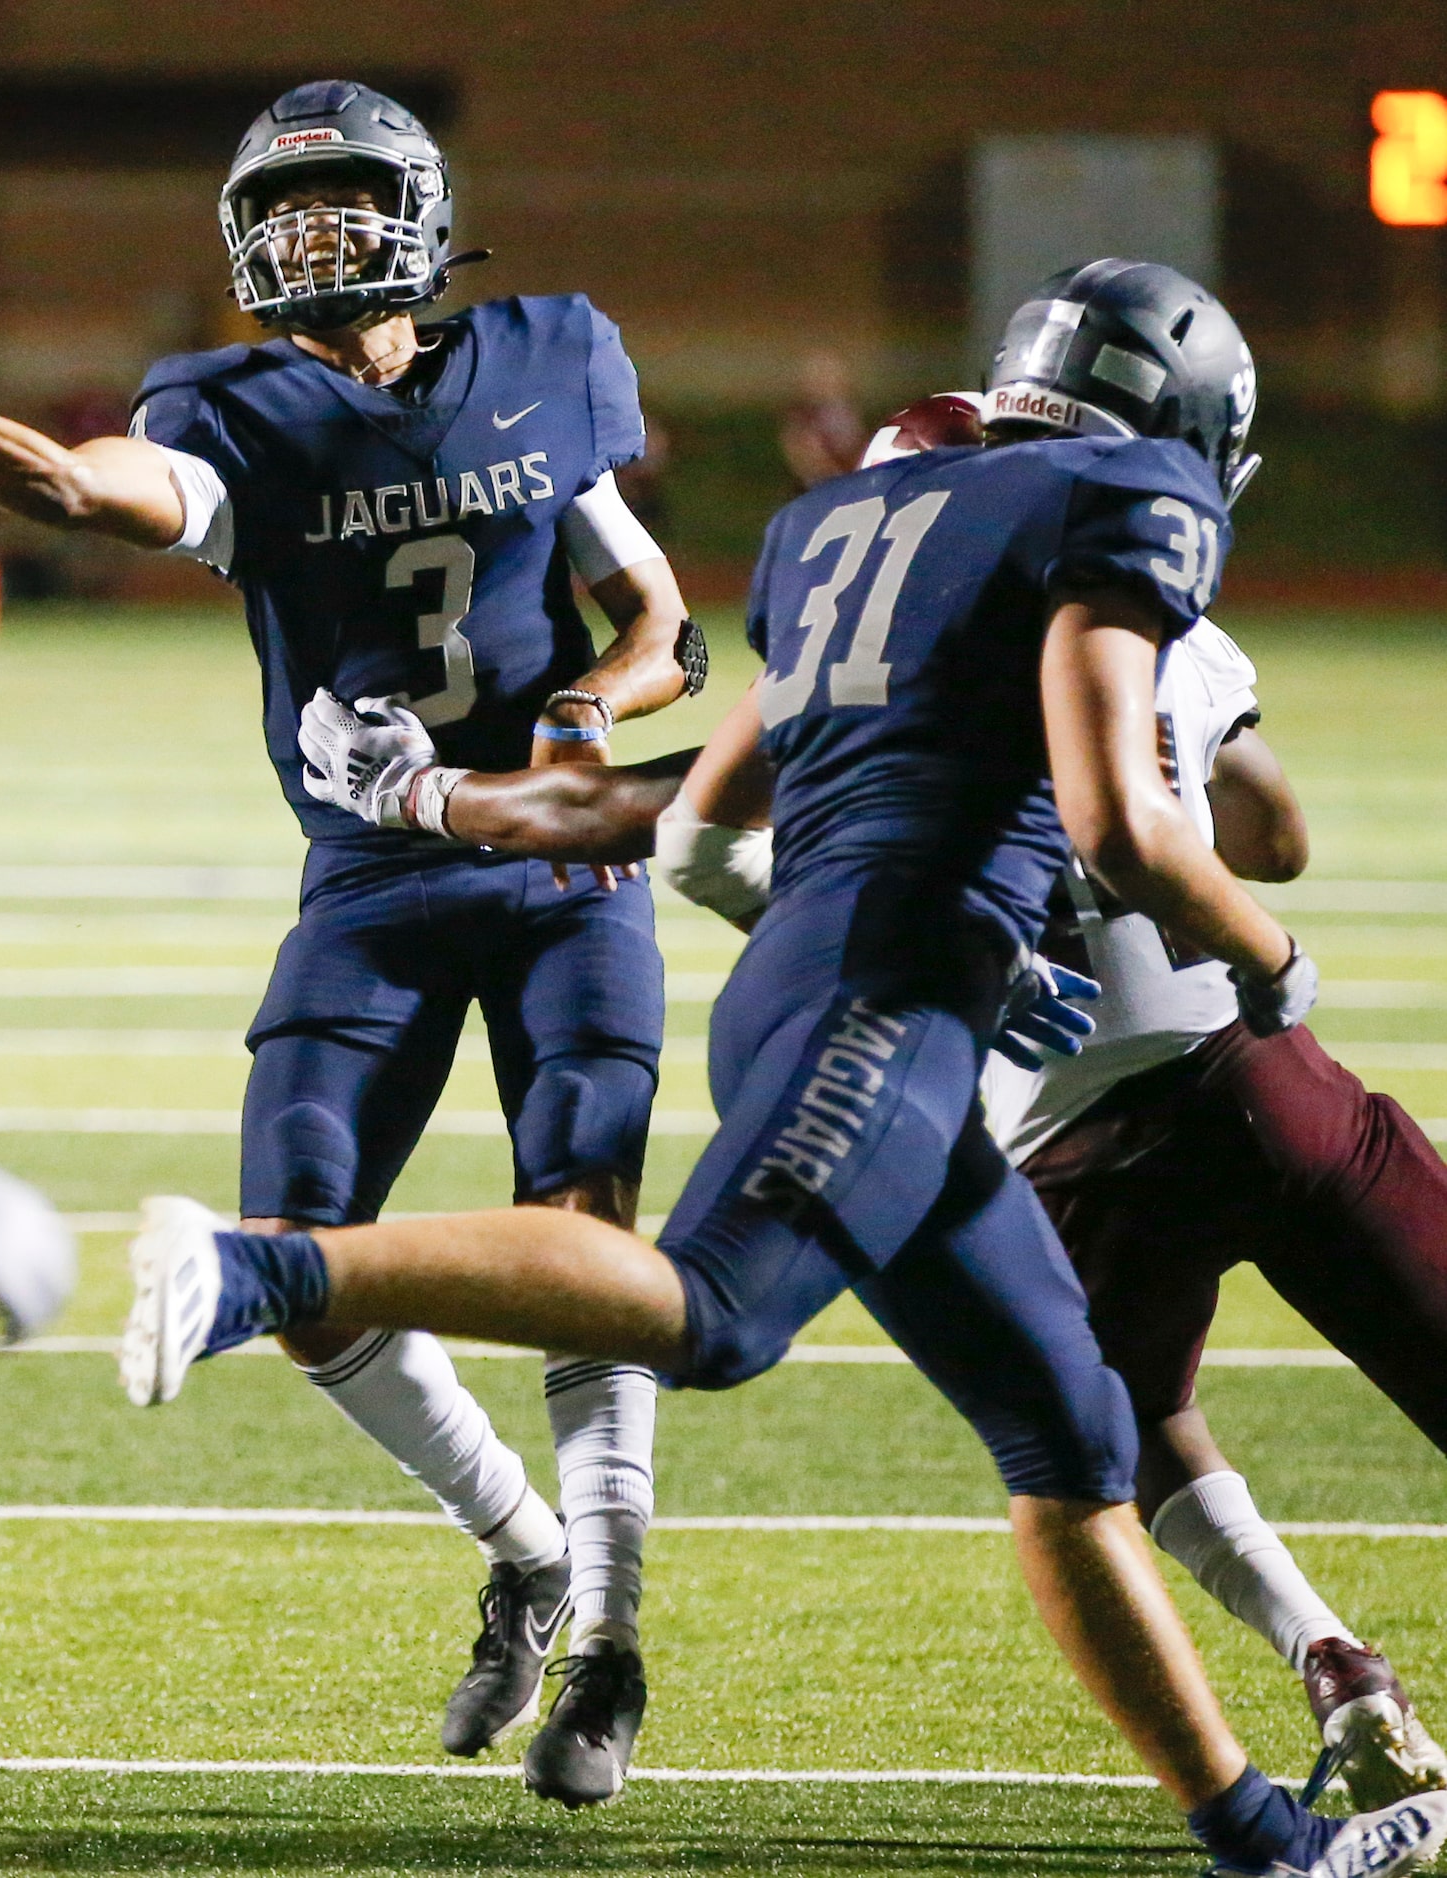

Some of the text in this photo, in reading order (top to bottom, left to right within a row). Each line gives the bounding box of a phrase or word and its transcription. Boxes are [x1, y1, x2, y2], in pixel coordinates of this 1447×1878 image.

[277, 131, 333, 147] Riddell
[996, 391, 1082, 427] Riddell
[305, 452, 554, 543] JAGUARS
[1149, 495, 1220, 608] 31
[385, 534, 477, 730] 3
[760, 490, 953, 731] 31
[350, 755, 391, 800] adidas
